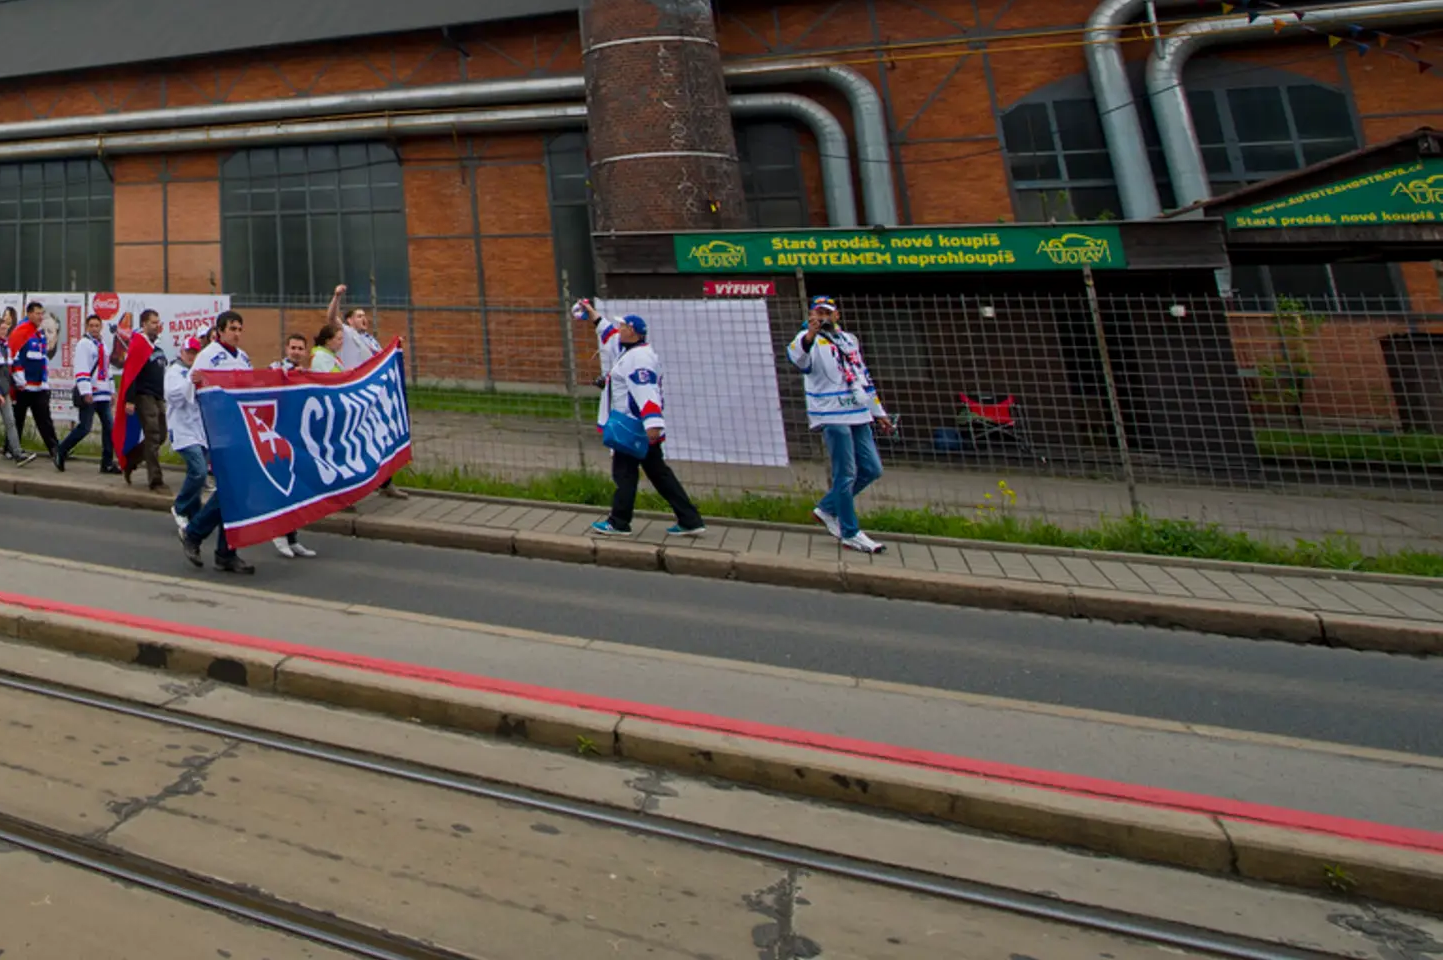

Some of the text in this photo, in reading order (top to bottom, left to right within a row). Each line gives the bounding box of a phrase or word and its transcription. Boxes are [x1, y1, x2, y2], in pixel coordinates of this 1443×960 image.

[1340, 211, 1378, 223] nové
[770, 232, 1002, 251] Staré prodáš, nové koupíš
[763, 249, 1017, 267] s AUTOTEAMEM neprohloupíš
[713, 280, 771, 295] VÝFUKY
